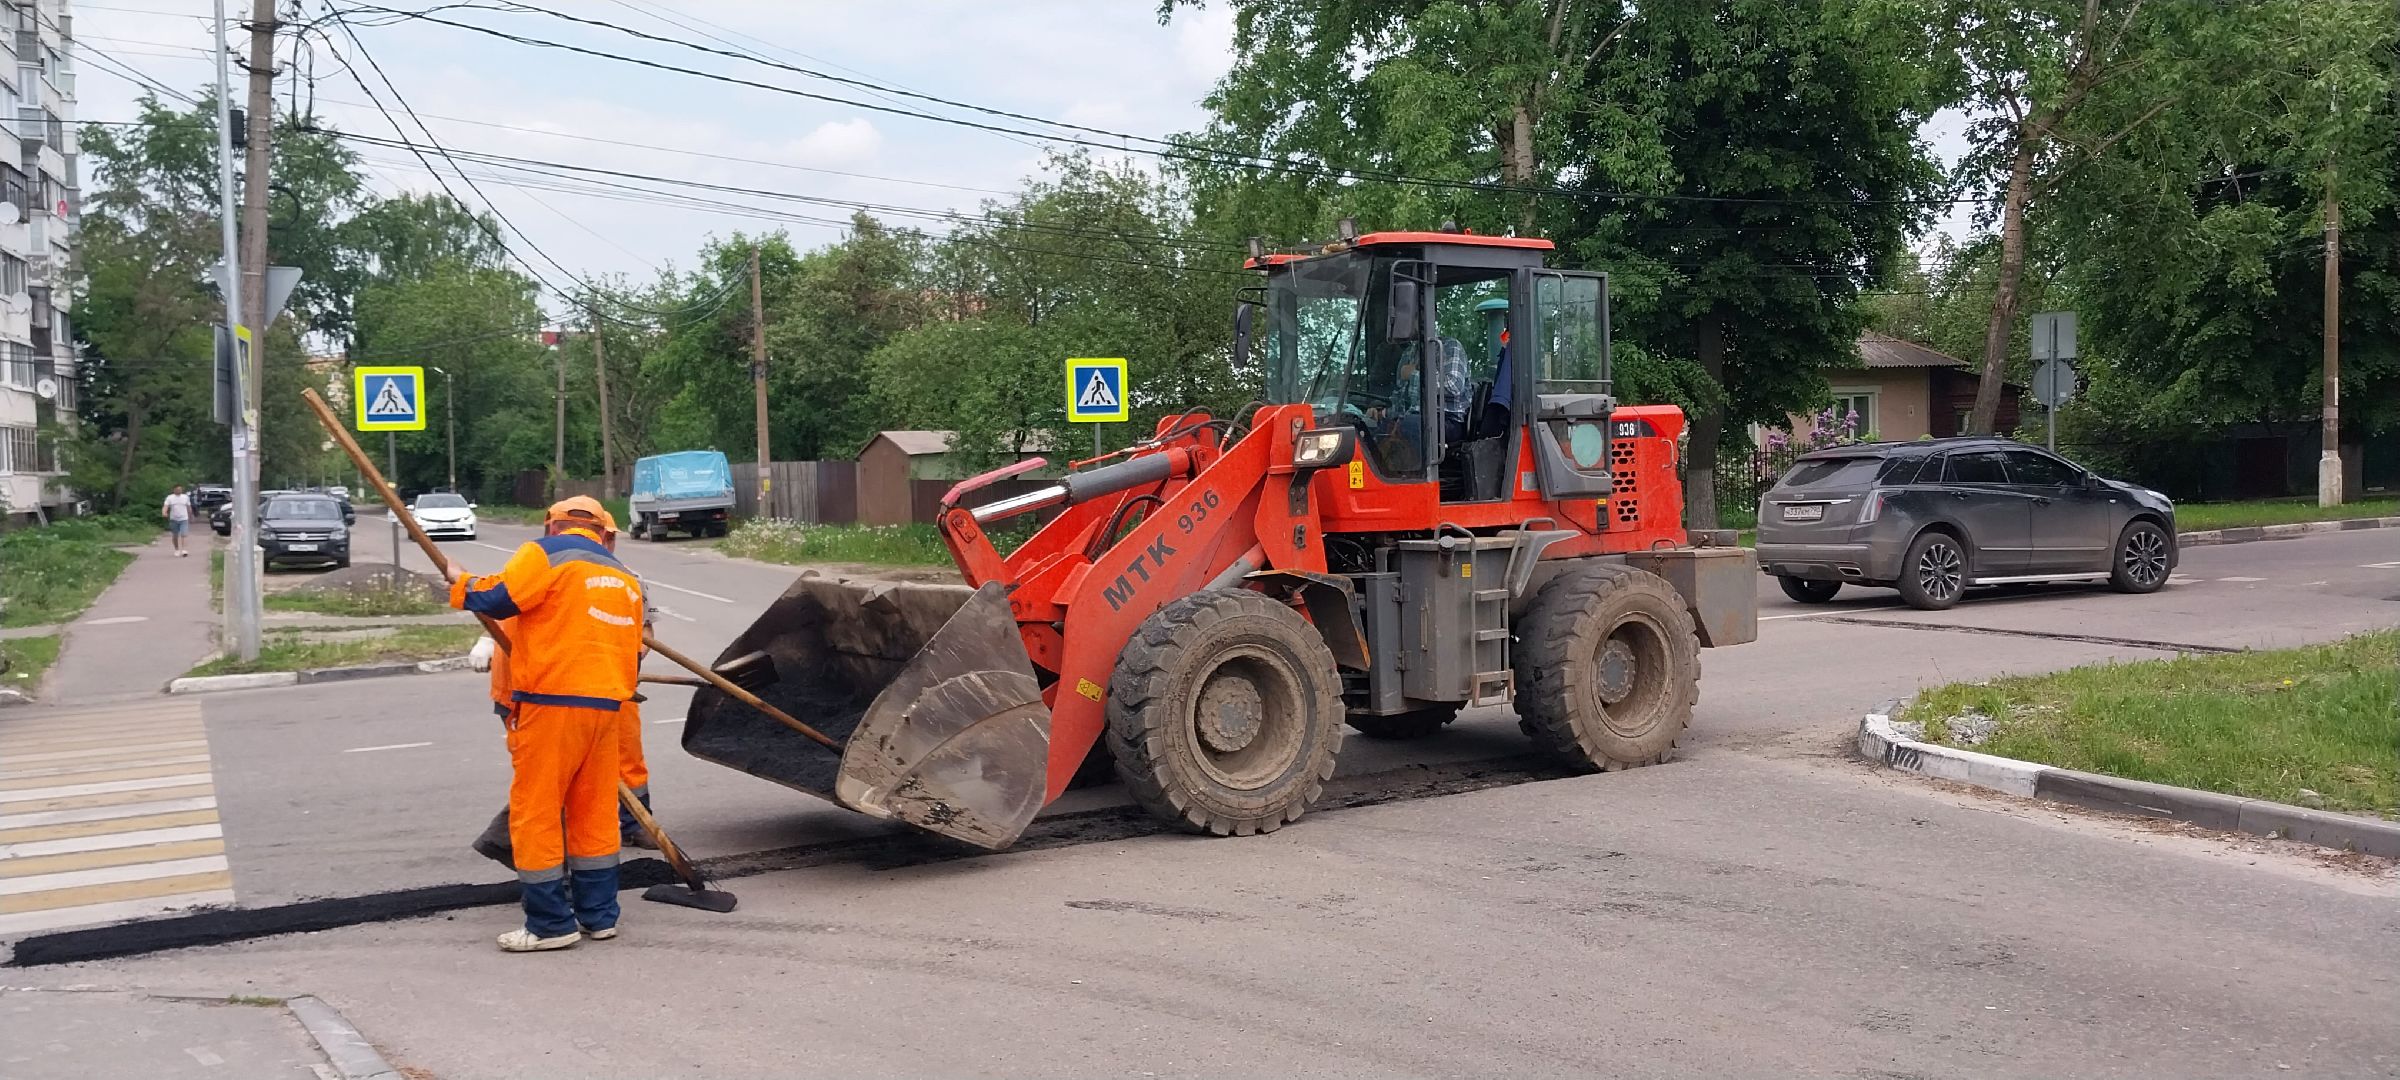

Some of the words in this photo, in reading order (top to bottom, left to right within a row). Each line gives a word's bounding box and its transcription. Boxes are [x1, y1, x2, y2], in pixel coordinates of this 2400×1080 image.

[1619, 423, 1635, 436] 936
[1103, 533, 1177, 612] MTK
[1177, 489, 1220, 535] 936
